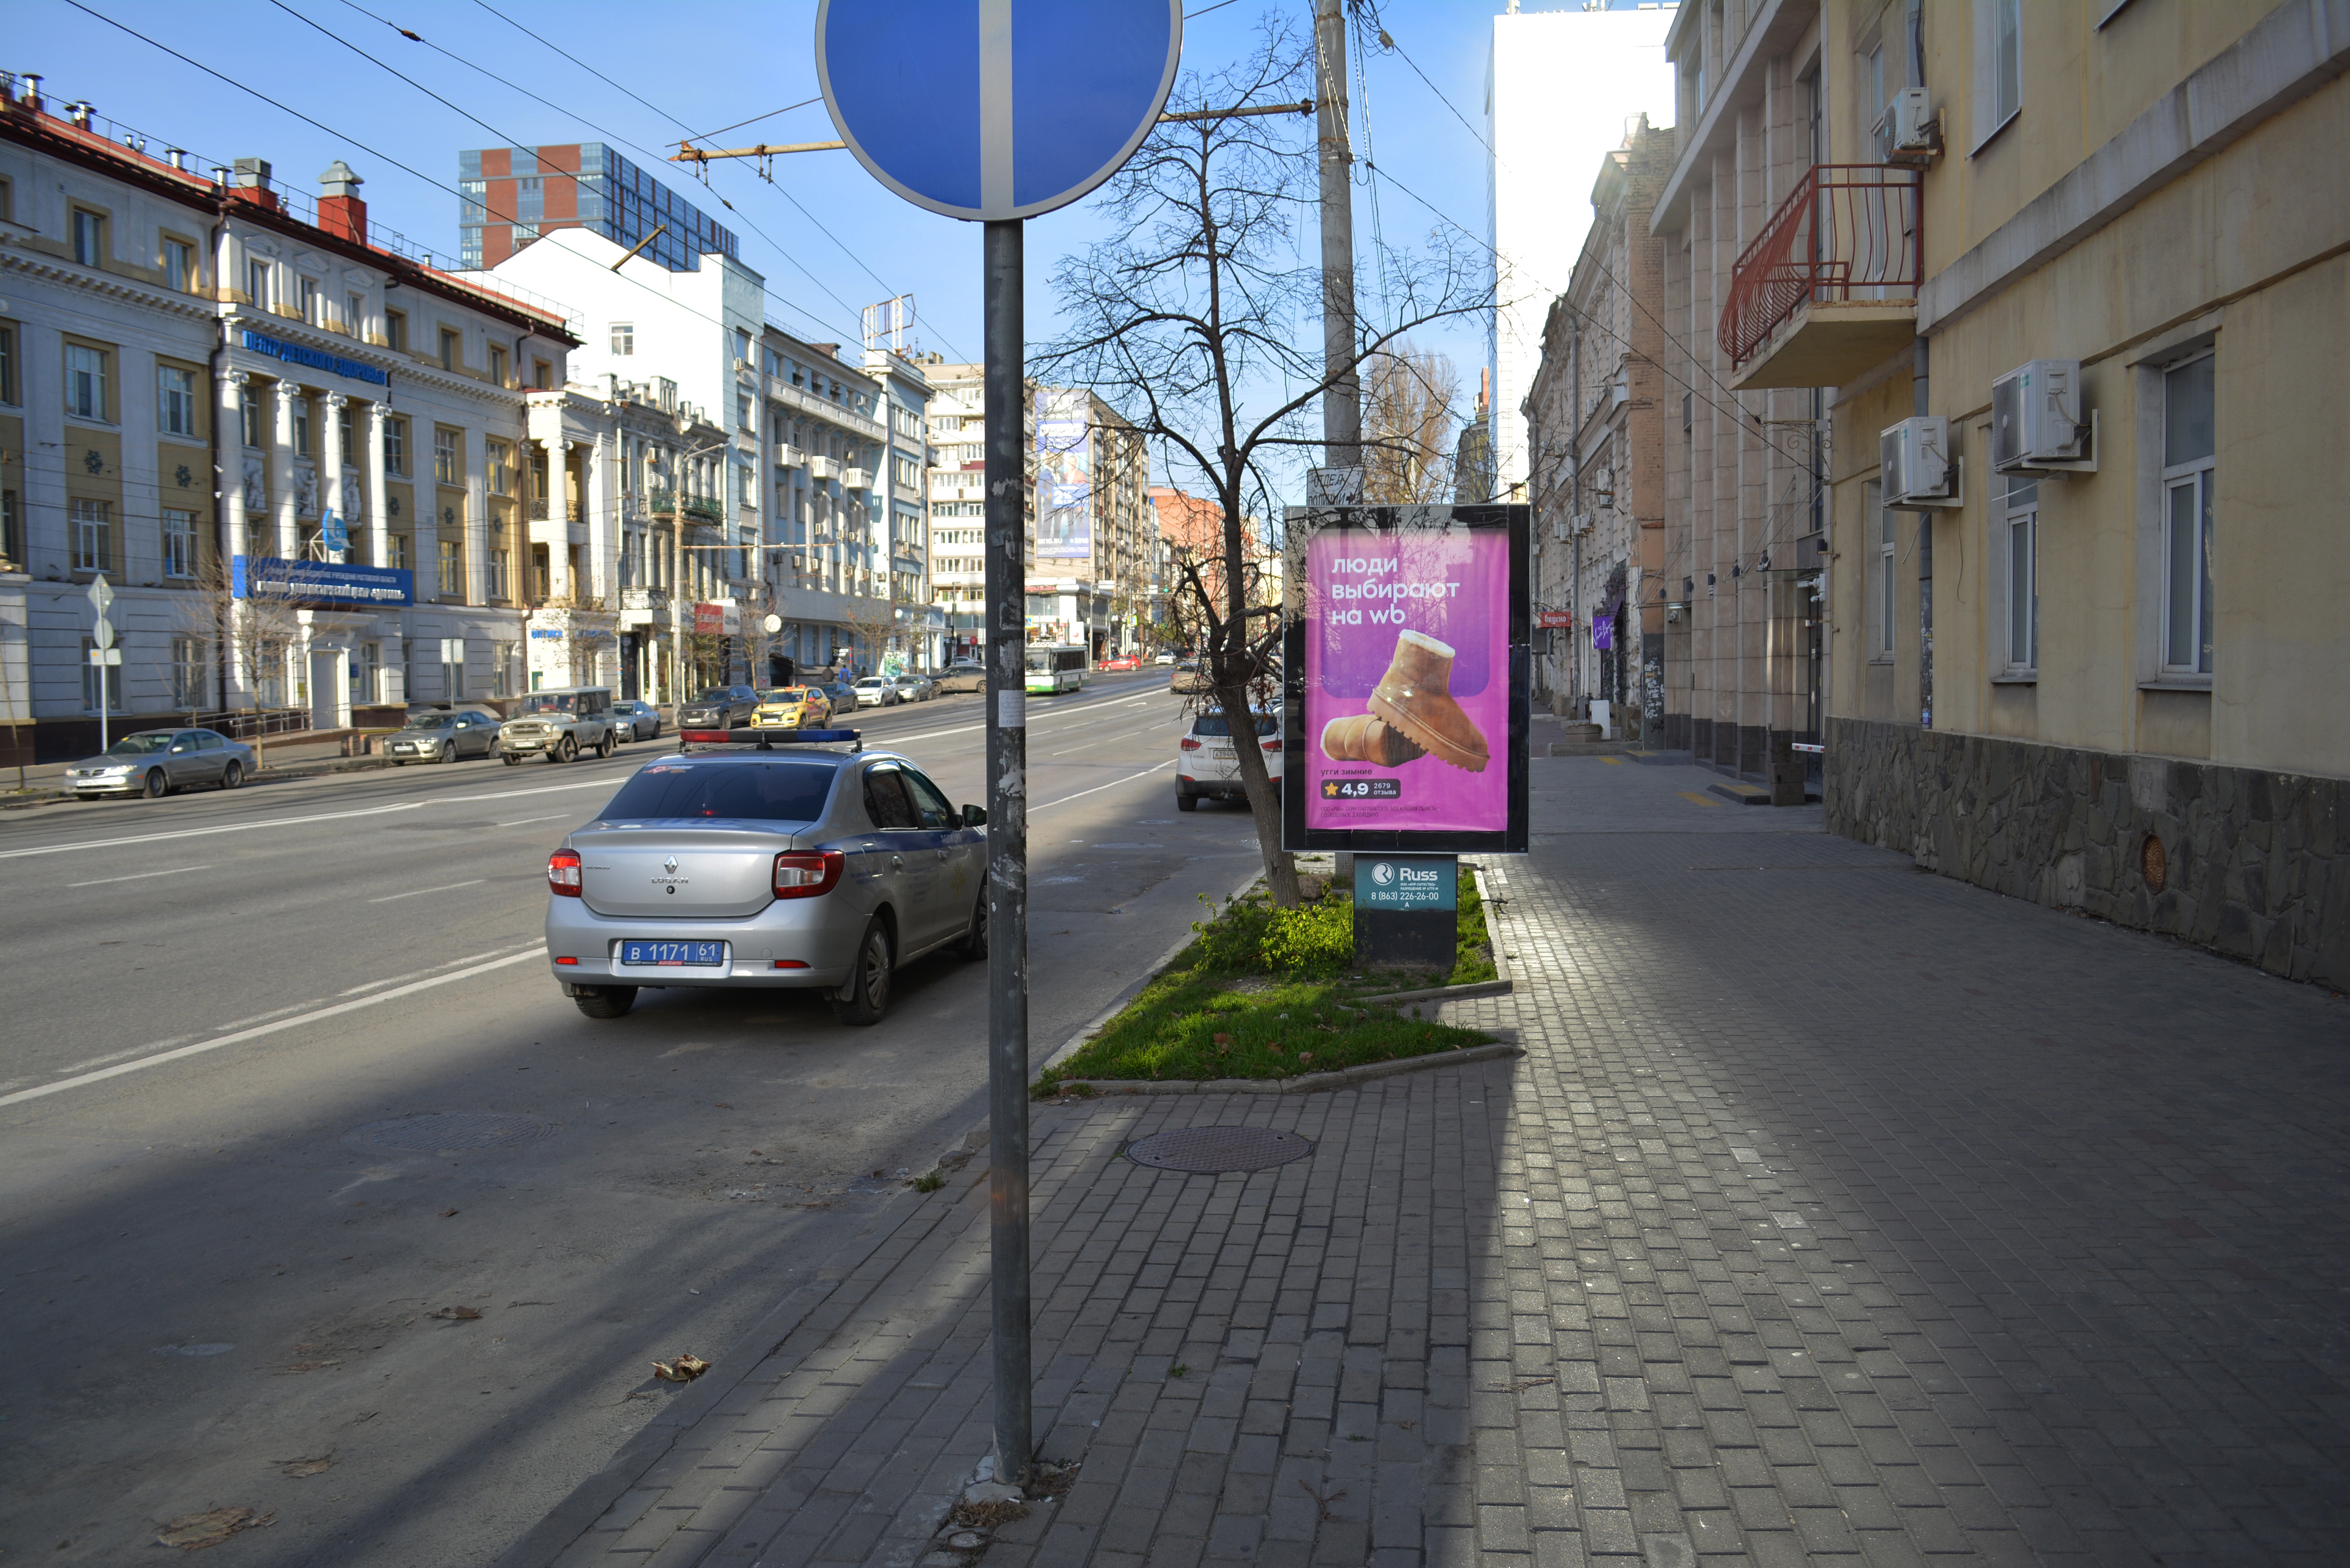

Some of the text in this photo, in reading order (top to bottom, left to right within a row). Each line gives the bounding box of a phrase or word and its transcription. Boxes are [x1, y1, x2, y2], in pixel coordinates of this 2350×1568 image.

[242, 330, 386, 385] ЦЕНТР ДЕТСКОГО ЗДОРОВЬЯ
[1314, 473, 1344, 488] ОТДЕЛ
[1331, 557, 1398, 575] люди
[1331, 578, 1460, 603] выбирают
[1331, 604, 1406, 625] на wb
[1545, 614, 1566, 625] вкусно
[531, 629, 563, 639] ОПТИКА
[1341, 783, 1369, 797] 4,9
[1400, 868, 1438, 881] Russ
[1378, 891, 1398, 901] (863)
[1400, 892, 1439, 900] 226-26-00
[649, 943, 689, 960] 1171
[699, 943, 716, 956] 61
